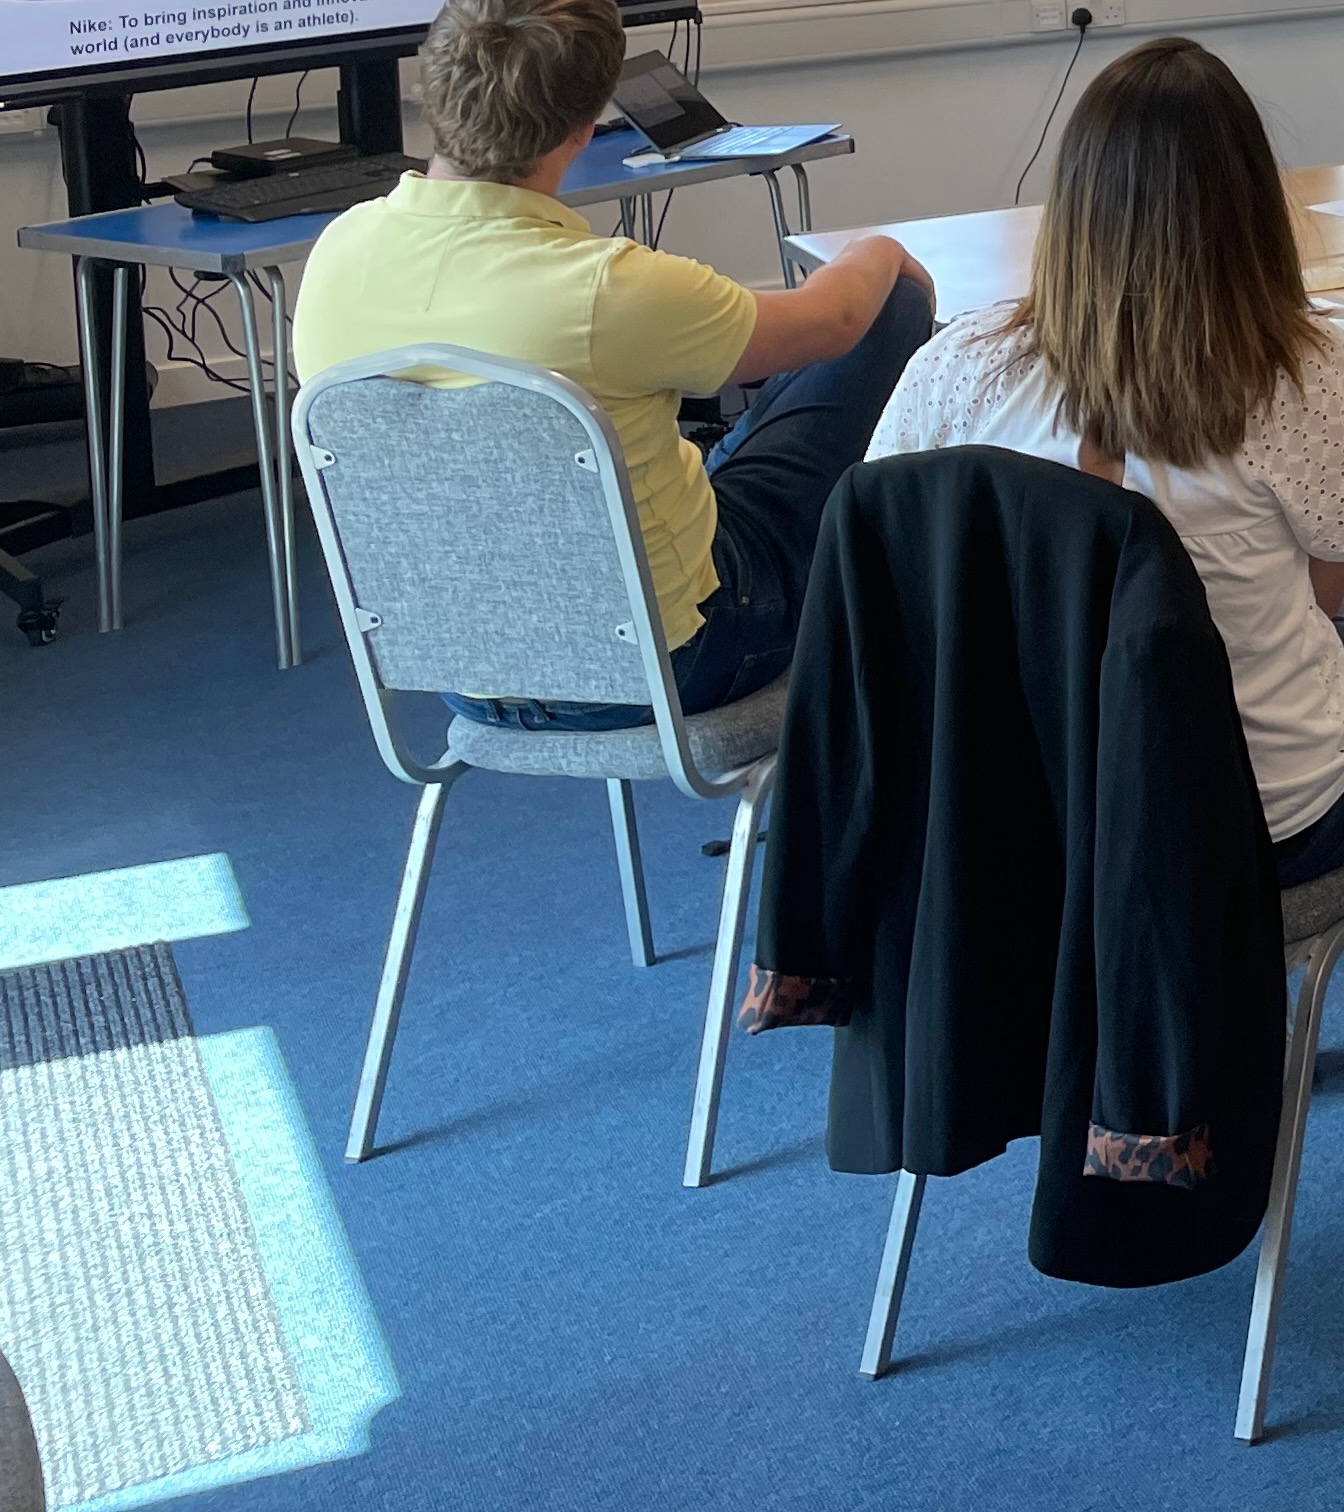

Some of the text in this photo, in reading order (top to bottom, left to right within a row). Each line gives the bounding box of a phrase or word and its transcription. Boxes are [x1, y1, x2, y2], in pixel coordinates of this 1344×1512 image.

[70, 19, 113, 35] Nike:
[119, 15, 138, 29] To
[144, 11, 187, 27] bring
[192, 0, 278, 21] inspiration
[70, 9, 359, 55] world (and everybody is an athlete).
